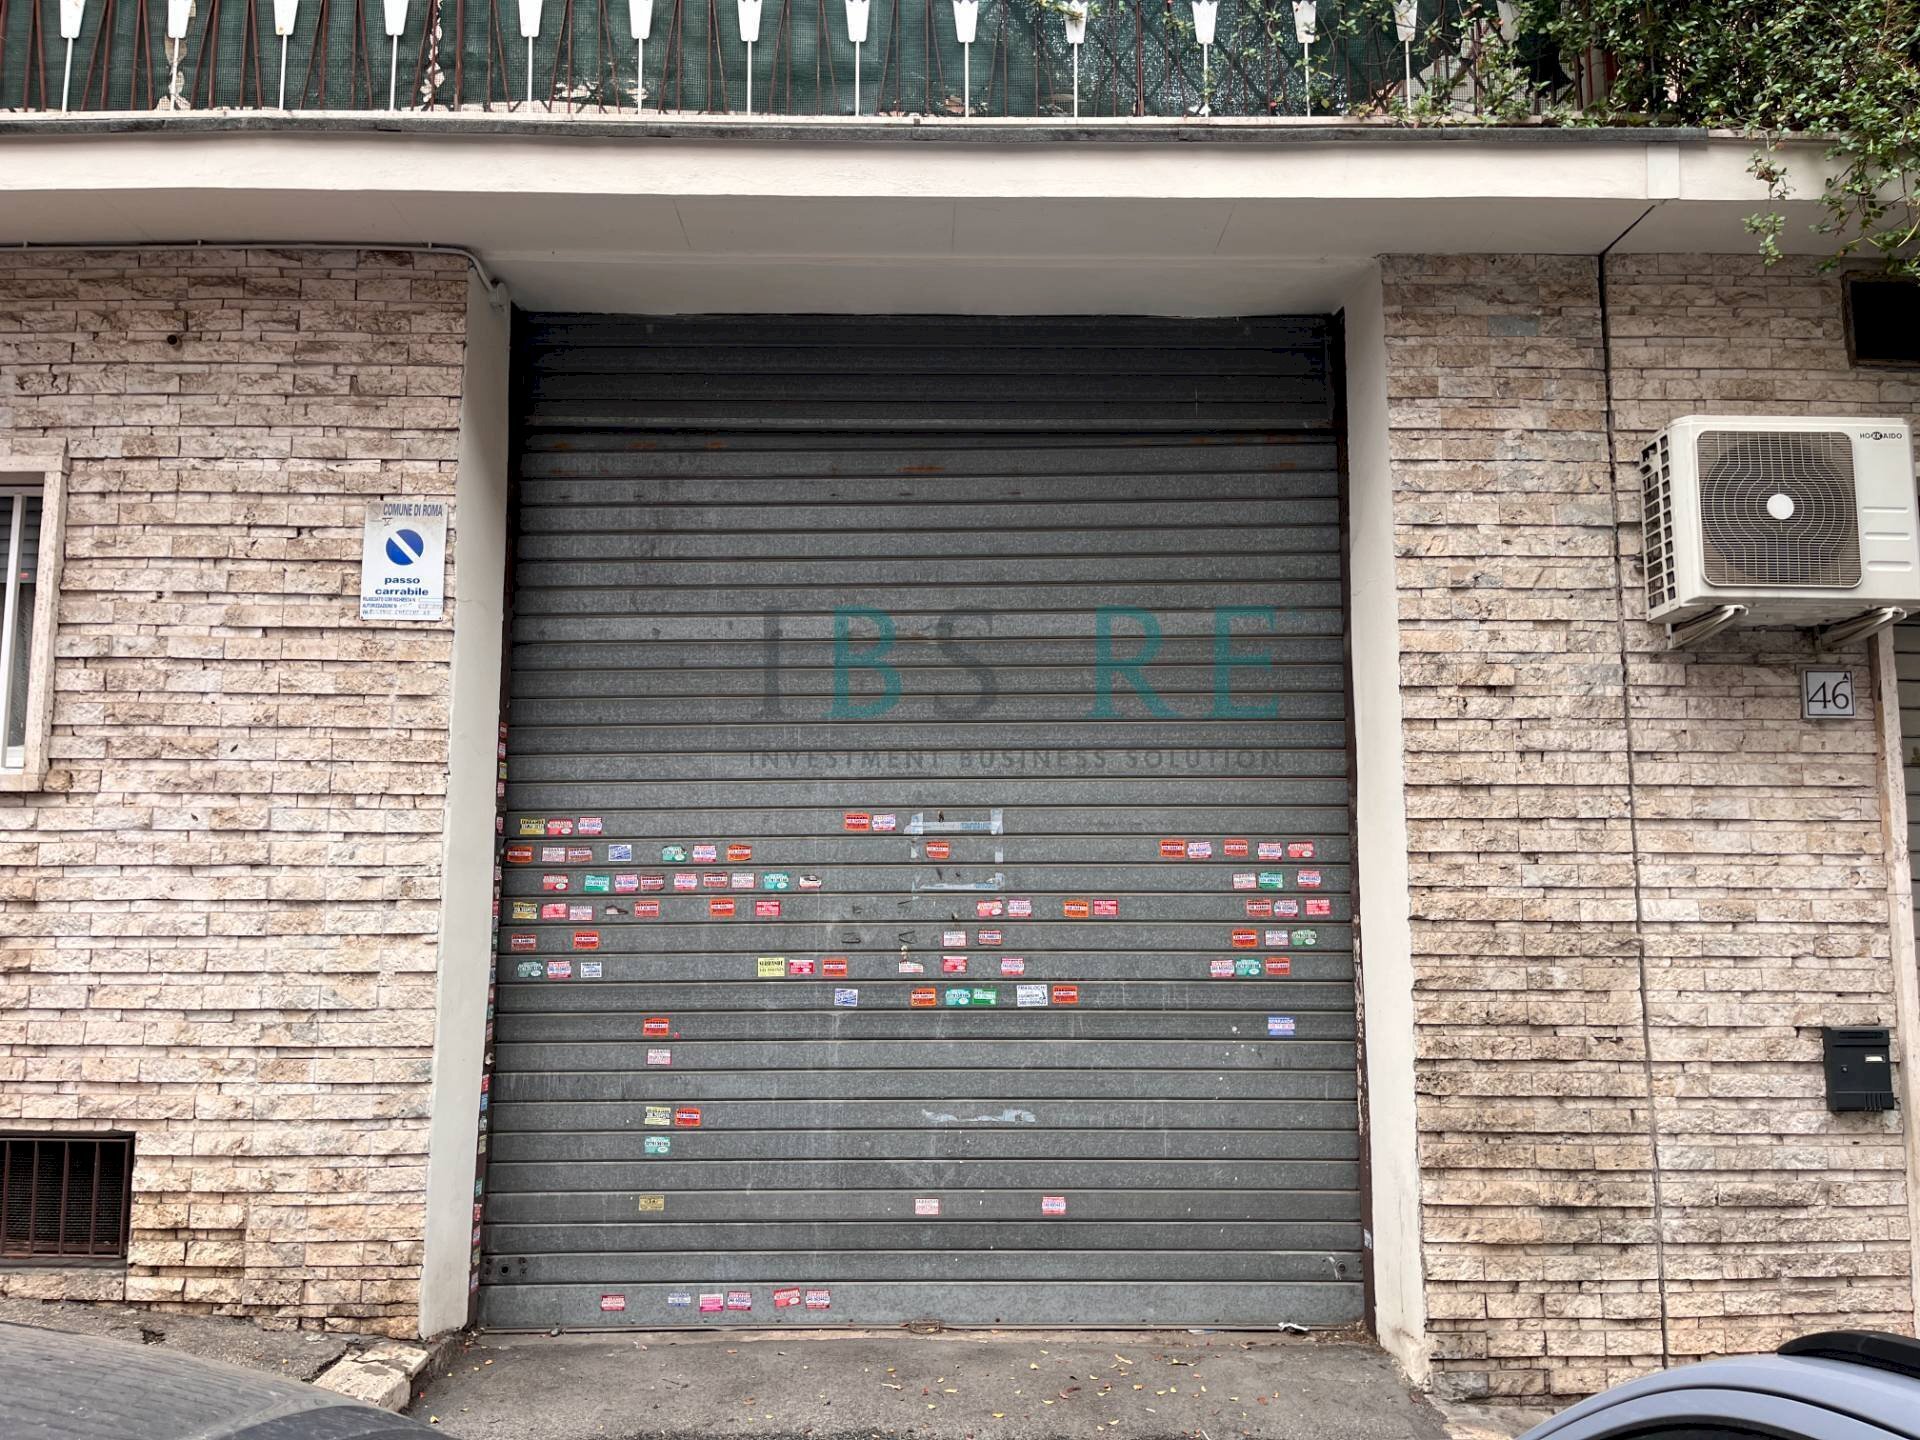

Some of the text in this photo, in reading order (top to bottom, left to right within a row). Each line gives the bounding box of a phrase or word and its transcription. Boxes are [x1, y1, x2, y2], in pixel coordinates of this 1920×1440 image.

[1859, 431, 1903, 441] HOKKAIDO
[383, 503, 443, 517] COMUNE DI ROMA
[384, 577, 421, 585] passo
[374, 587, 429, 596] carrabile
[1808, 680, 1849, 709] 46
